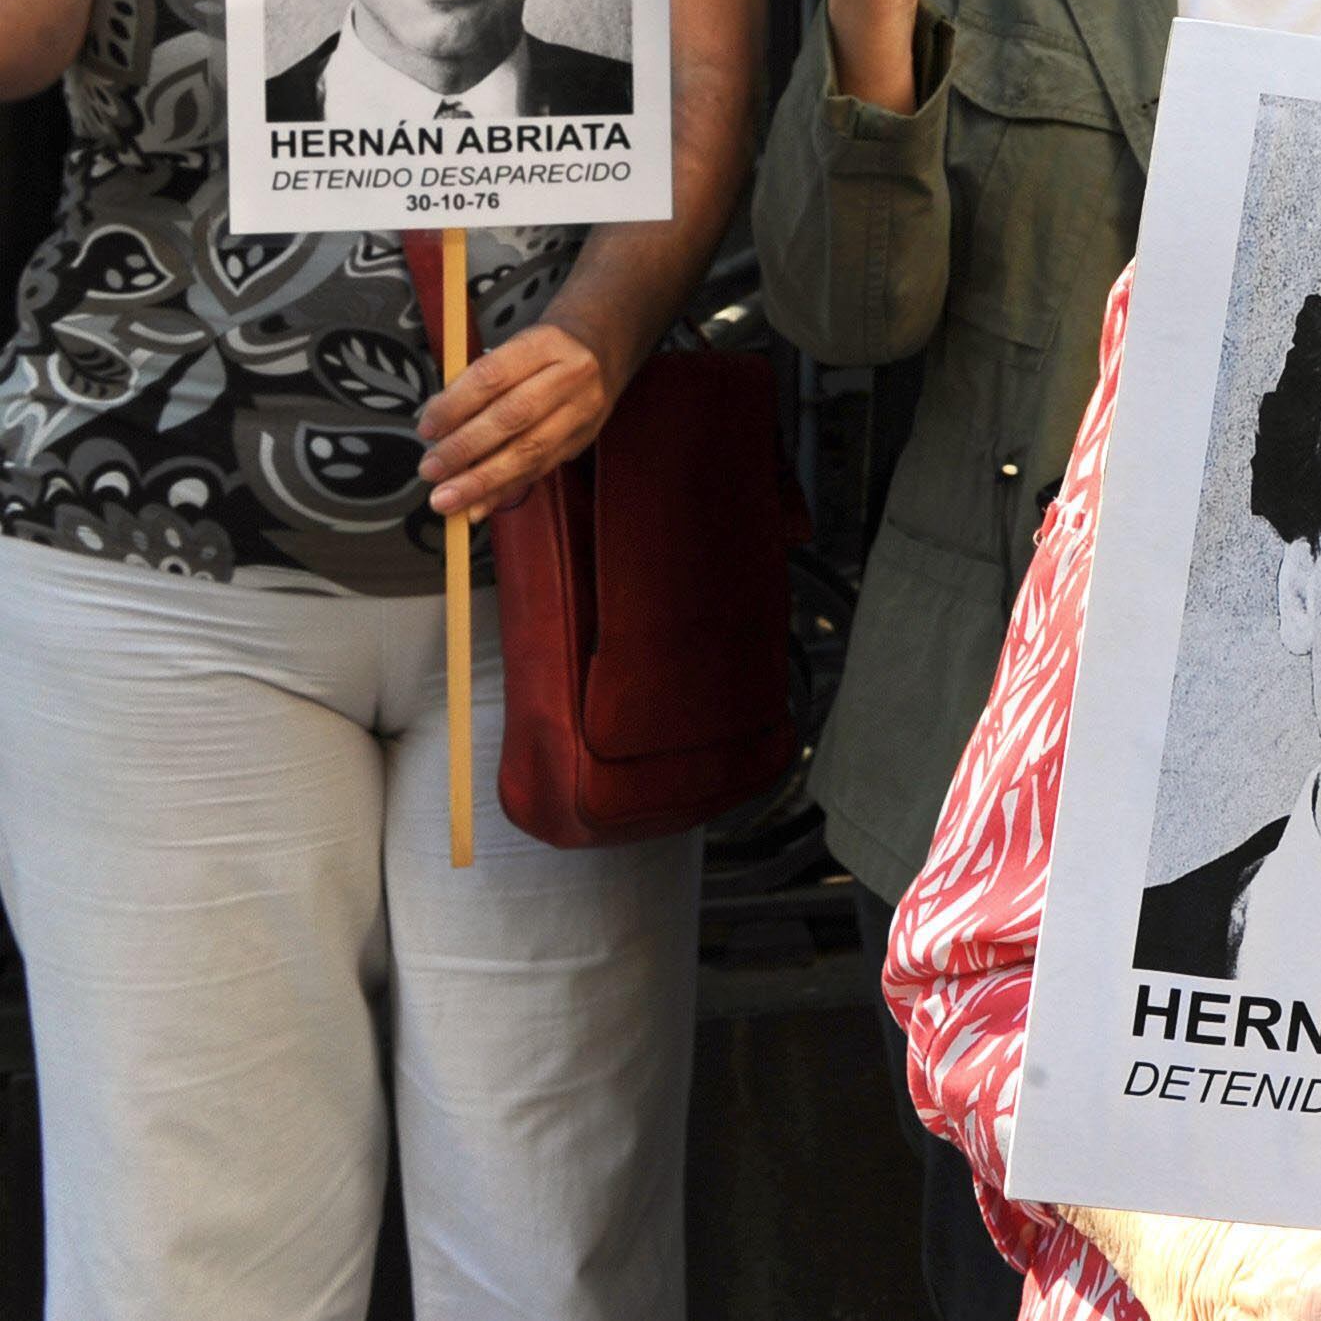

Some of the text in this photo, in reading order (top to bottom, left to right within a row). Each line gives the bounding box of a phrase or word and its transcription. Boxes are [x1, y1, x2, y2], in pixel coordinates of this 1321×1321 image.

[270, 120, 632, 159] HERNÁN ABRIATA
[271, 161, 632, 191] DETENIDO DESAPARECIDO
[405, 192, 501, 212] 30-10-76
